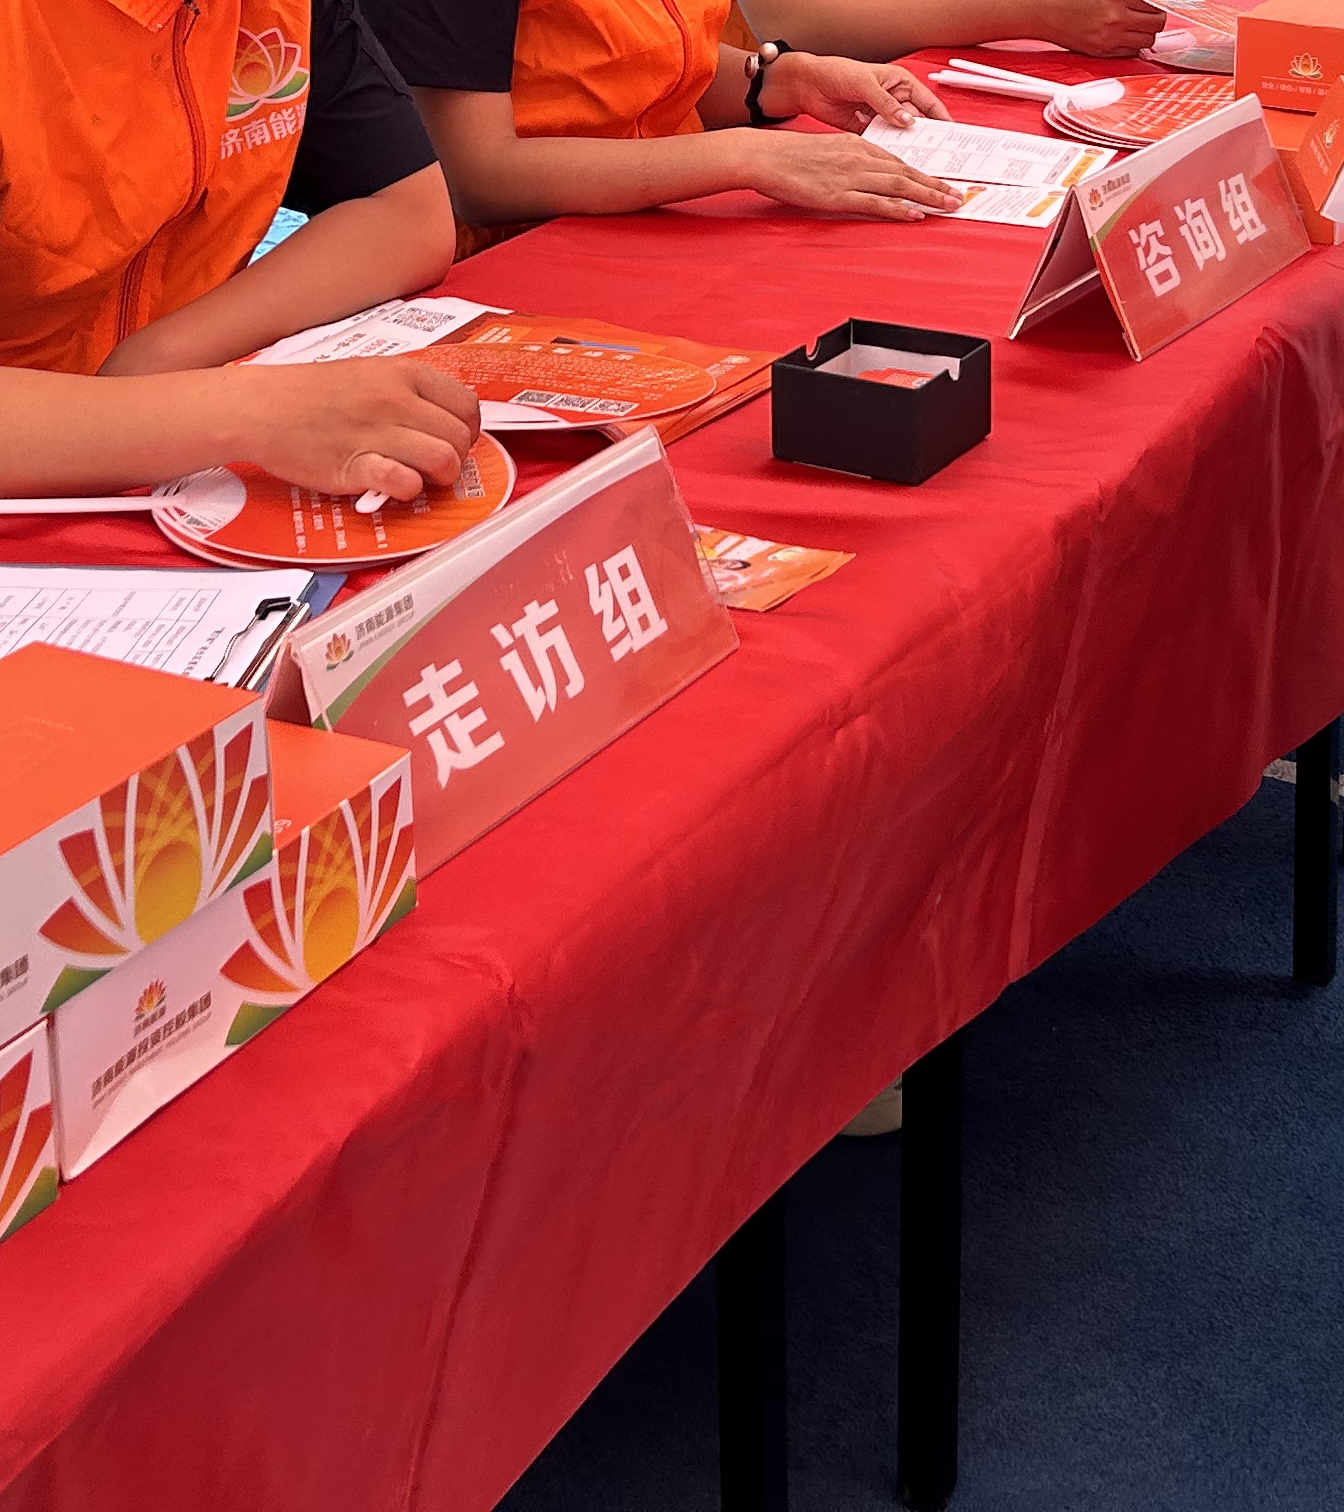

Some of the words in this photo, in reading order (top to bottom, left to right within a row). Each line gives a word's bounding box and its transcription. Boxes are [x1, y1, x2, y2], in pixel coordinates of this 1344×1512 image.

[1128, 172, 1269, 297] 咨询组
[402, 544, 669, 789] 走访组
